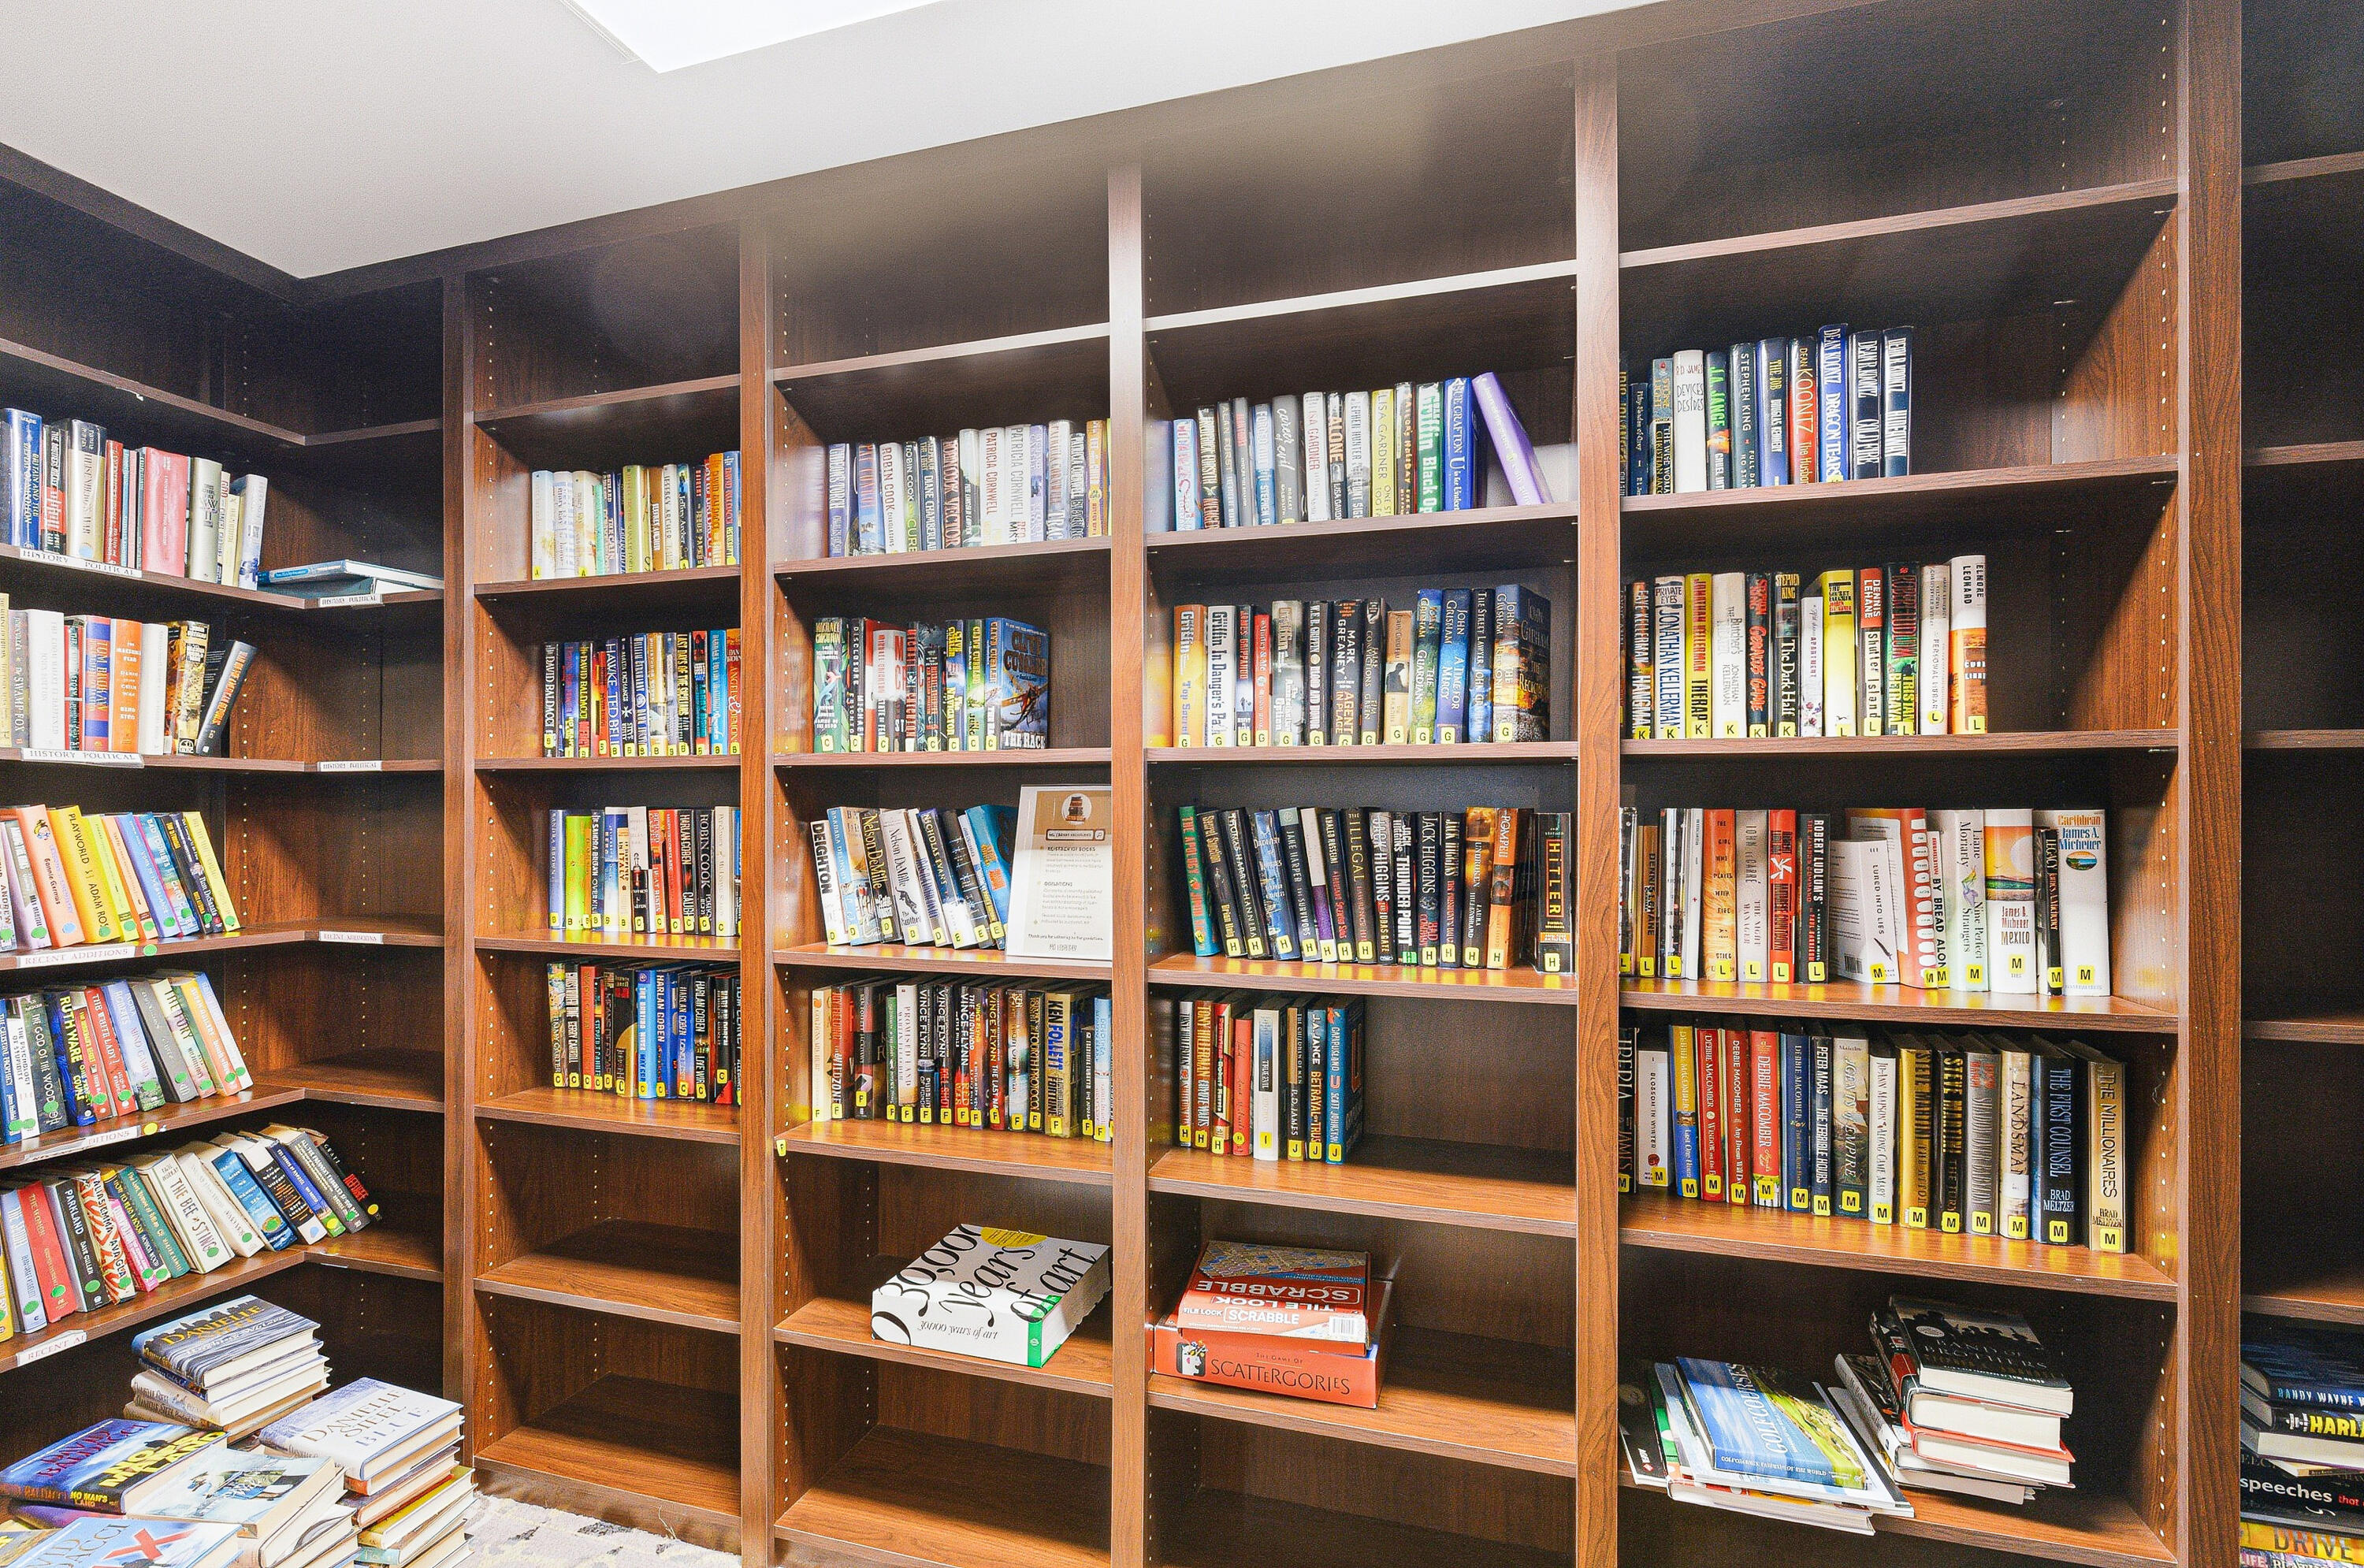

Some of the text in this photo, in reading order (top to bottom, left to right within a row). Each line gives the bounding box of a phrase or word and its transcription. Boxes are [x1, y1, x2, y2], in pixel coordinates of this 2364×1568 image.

[1710, 392, 1725, 427] JANCE
[1740, 351, 1751, 431] STEPHEN KING
[1796, 347, 1814, 433] DEAN KOONTZ
[1825, 392, 1841, 429] DRAGON
[1377, 392, 1388, 479] LISA GARDNER
[1857, 418, 1879, 465] COLD FIRE
[1885, 409, 1907, 457] HIDEAWAY
[881, 447, 895, 510] ROBIN COOK
[985, 432, 997, 515] PATRICIA CORNWELL
[1011, 427, 1024, 517] PATRICIA CORNWELL
[1864, 578, 1872, 619] LEHANE
[1871, 578, 1880, 618] DENNIS
[1962, 565, 1972, 604] LEONARD
[1444, 599, 1456, 645] GRISHAM
[1456, 608, 1466, 636] JOHN
[1658, 610, 1674, 666] JONATHAN
[96, 640, 108, 661] TOM
[606, 643, 618, 691] HAWKE
[1210, 609, 1229, 708] Griffin In Danger's
[1337, 617, 1347, 676] GREANEY
[1346, 628, 1356, 663] MARK
[1865, 631, 1879, 719] Shutter Island
[13, 708, 25, 733] FOX
[1344, 691, 1354, 734] AGENT
[30, 750, 136, 760] HISTORY POLITICAL
[1003, 730, 1026, 748] THE
[69, 813, 90, 864] PLAYWORLD
[1958, 820, 1972, 868] Moriarty
[2057, 815, 2102, 827] Caribbean
[2061, 827, 2088, 839] James
[701, 814, 711, 889] ROBIN COOK
[812, 823, 833, 895] DEIGHTON
[861, 813, 883, 890] Nelson DeMille
[1348, 823, 1365, 882] ILLEGAL
[1422, 816, 1438, 895] JACK HIGGINS
[1812, 819, 1824, 906] ROBERT LUDLUM'S
[2045, 838, 2058, 870] LEGACY
[2057, 838, 2102, 852] Michener
[89, 882, 104, 911] ADAM
[1376, 855, 1391, 901] HIGGINS
[1395, 855, 1411, 948] THUNDER POINT
[1934, 897, 1944, 933] BREAD
[25, 948, 128, 966] RECENT ADDITIONS
[34, 1027, 46, 1049] GOD
[59, 995, 83, 1064] RUTH WARE
[163, 990, 195, 1041] THE FURY
[937, 989, 946, 1058] VINCE FLYNN
[1047, 999, 1063, 1070] KEN FOLLETT
[920, 1020, 928, 1058] FLYNN
[1196, 1005, 1211, 1079] TONY HILLERMAN
[1310, 1030, 1322, 1113] JANCE BETRAYAL
[1943, 1057, 1964, 1096] STEVE
[1757, 1054, 1772, 1148] DEBBIE MACOMBER
[1816, 1046, 1829, 1184] PETER MAAS HOURS
[2050, 1068, 2072, 1178] THE FIRST COUNSEL
[2099, 1071, 2117, 1198] THE MILLIONAIRES
[65, 1189, 84, 1235] PARKLAND
[176, 1178, 189, 1201] THE
[182, 1198, 196, 1218] BEE
[2043, 1201, 2075, 1213] MELTZER
[2050, 1188, 2071, 1202] BRAD
[2099, 1208, 2118, 1219] BRAD
[937, 1245, 1036, 1328] years
[1005, 1247, 1098, 1324] of art
[1195, 1280, 1351, 1302] SCRABBLE
[1213, 1296, 1273, 1308] LOCK
[162, 1305, 266, 1345] DANIELLE
[1228, 1309, 1300, 1326] SCRABBLE
[28, 1341, 68, 1361] RECENT
[1210, 1358, 1351, 1395] SCATTERGORIES
[2278, 1388, 2354, 1407] RANDY WAYNE
[301, 1388, 408, 1443] DANIELLE
[142, 1431, 228, 1473] LAND
[2239, 1477, 2360, 1507] speeches that
[2273, 1526, 2354, 1562] DRIVE
